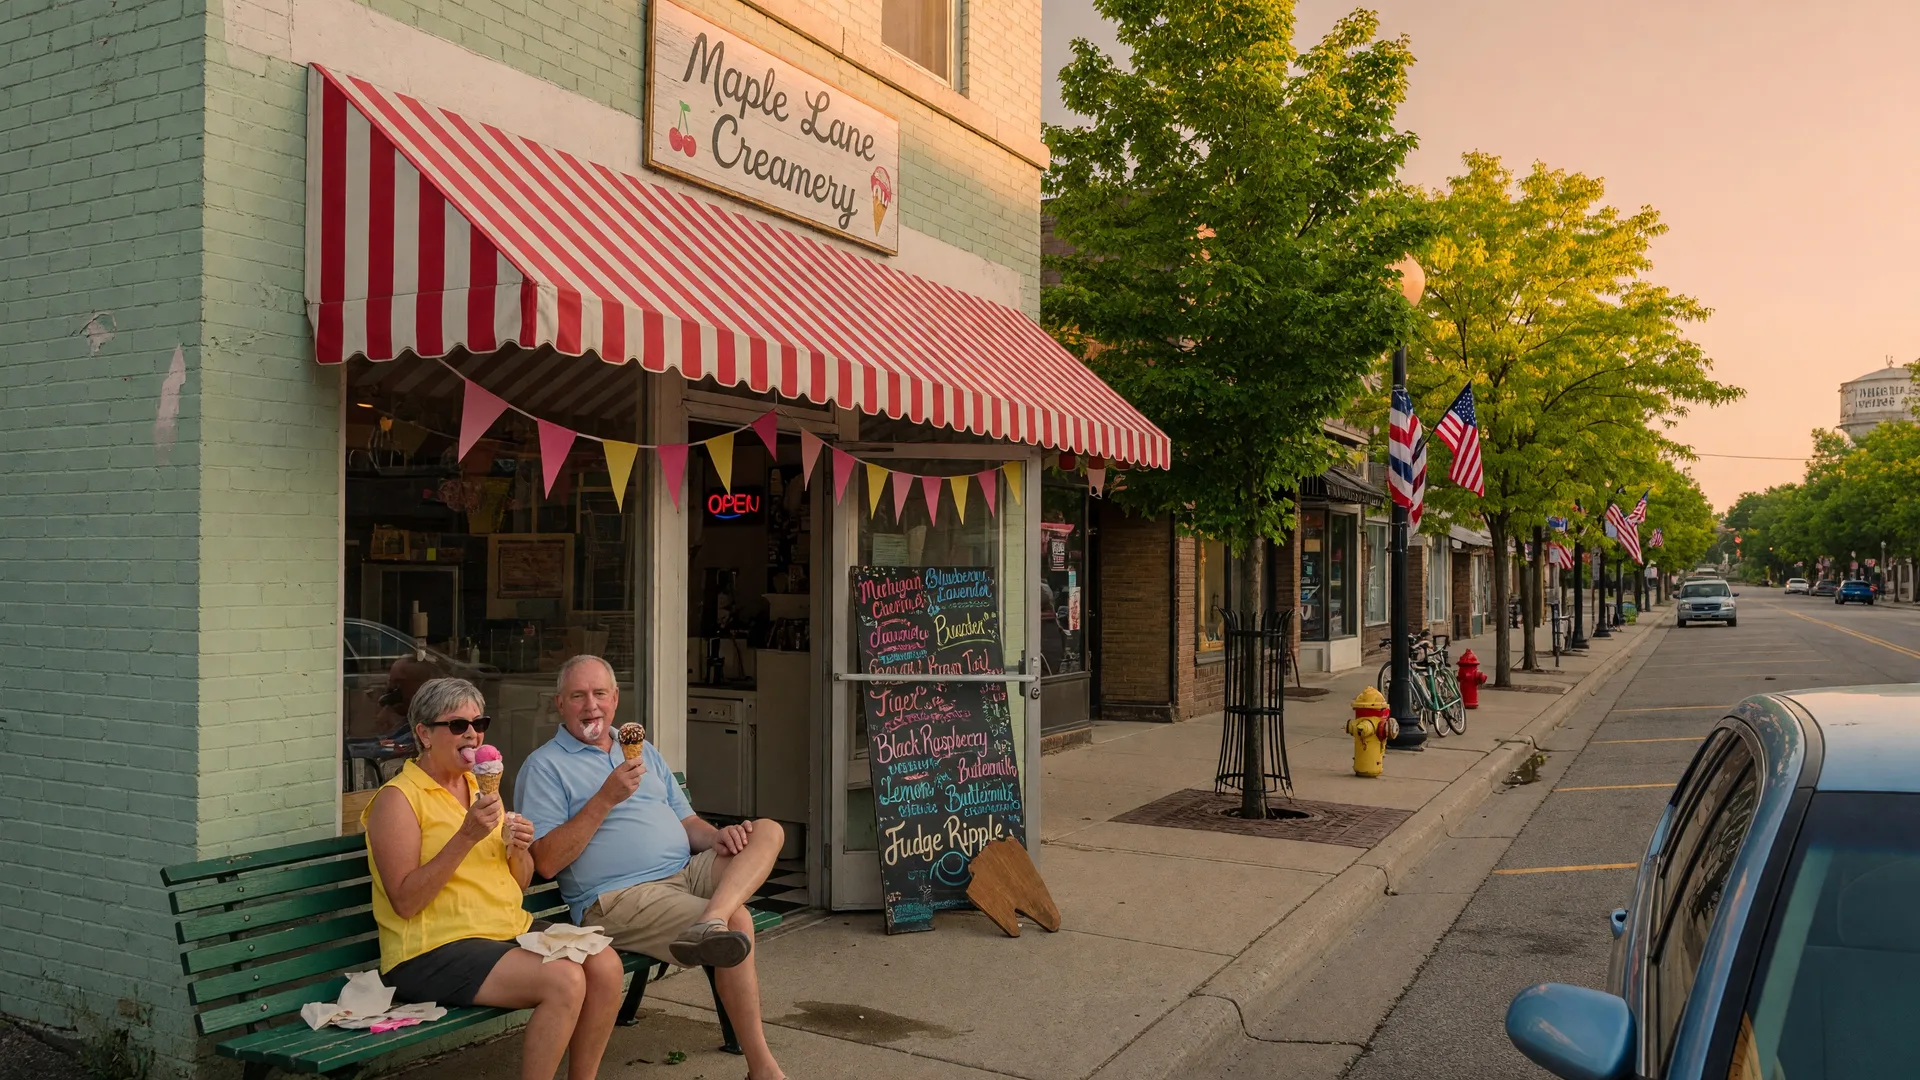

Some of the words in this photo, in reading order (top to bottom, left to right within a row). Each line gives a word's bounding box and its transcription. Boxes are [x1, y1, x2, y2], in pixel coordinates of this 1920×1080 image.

[682, 32, 789, 122] Maple
[800, 90, 876, 162] Lane
[711, 113, 858, 230] Creamery
[708, 493, 760, 514] OPEN
[873, 729, 921, 763] Black
[919, 724, 988, 758] Raspberry
[885, 820, 944, 866] Fudge
[943, 814, 1004, 857] Ripple
